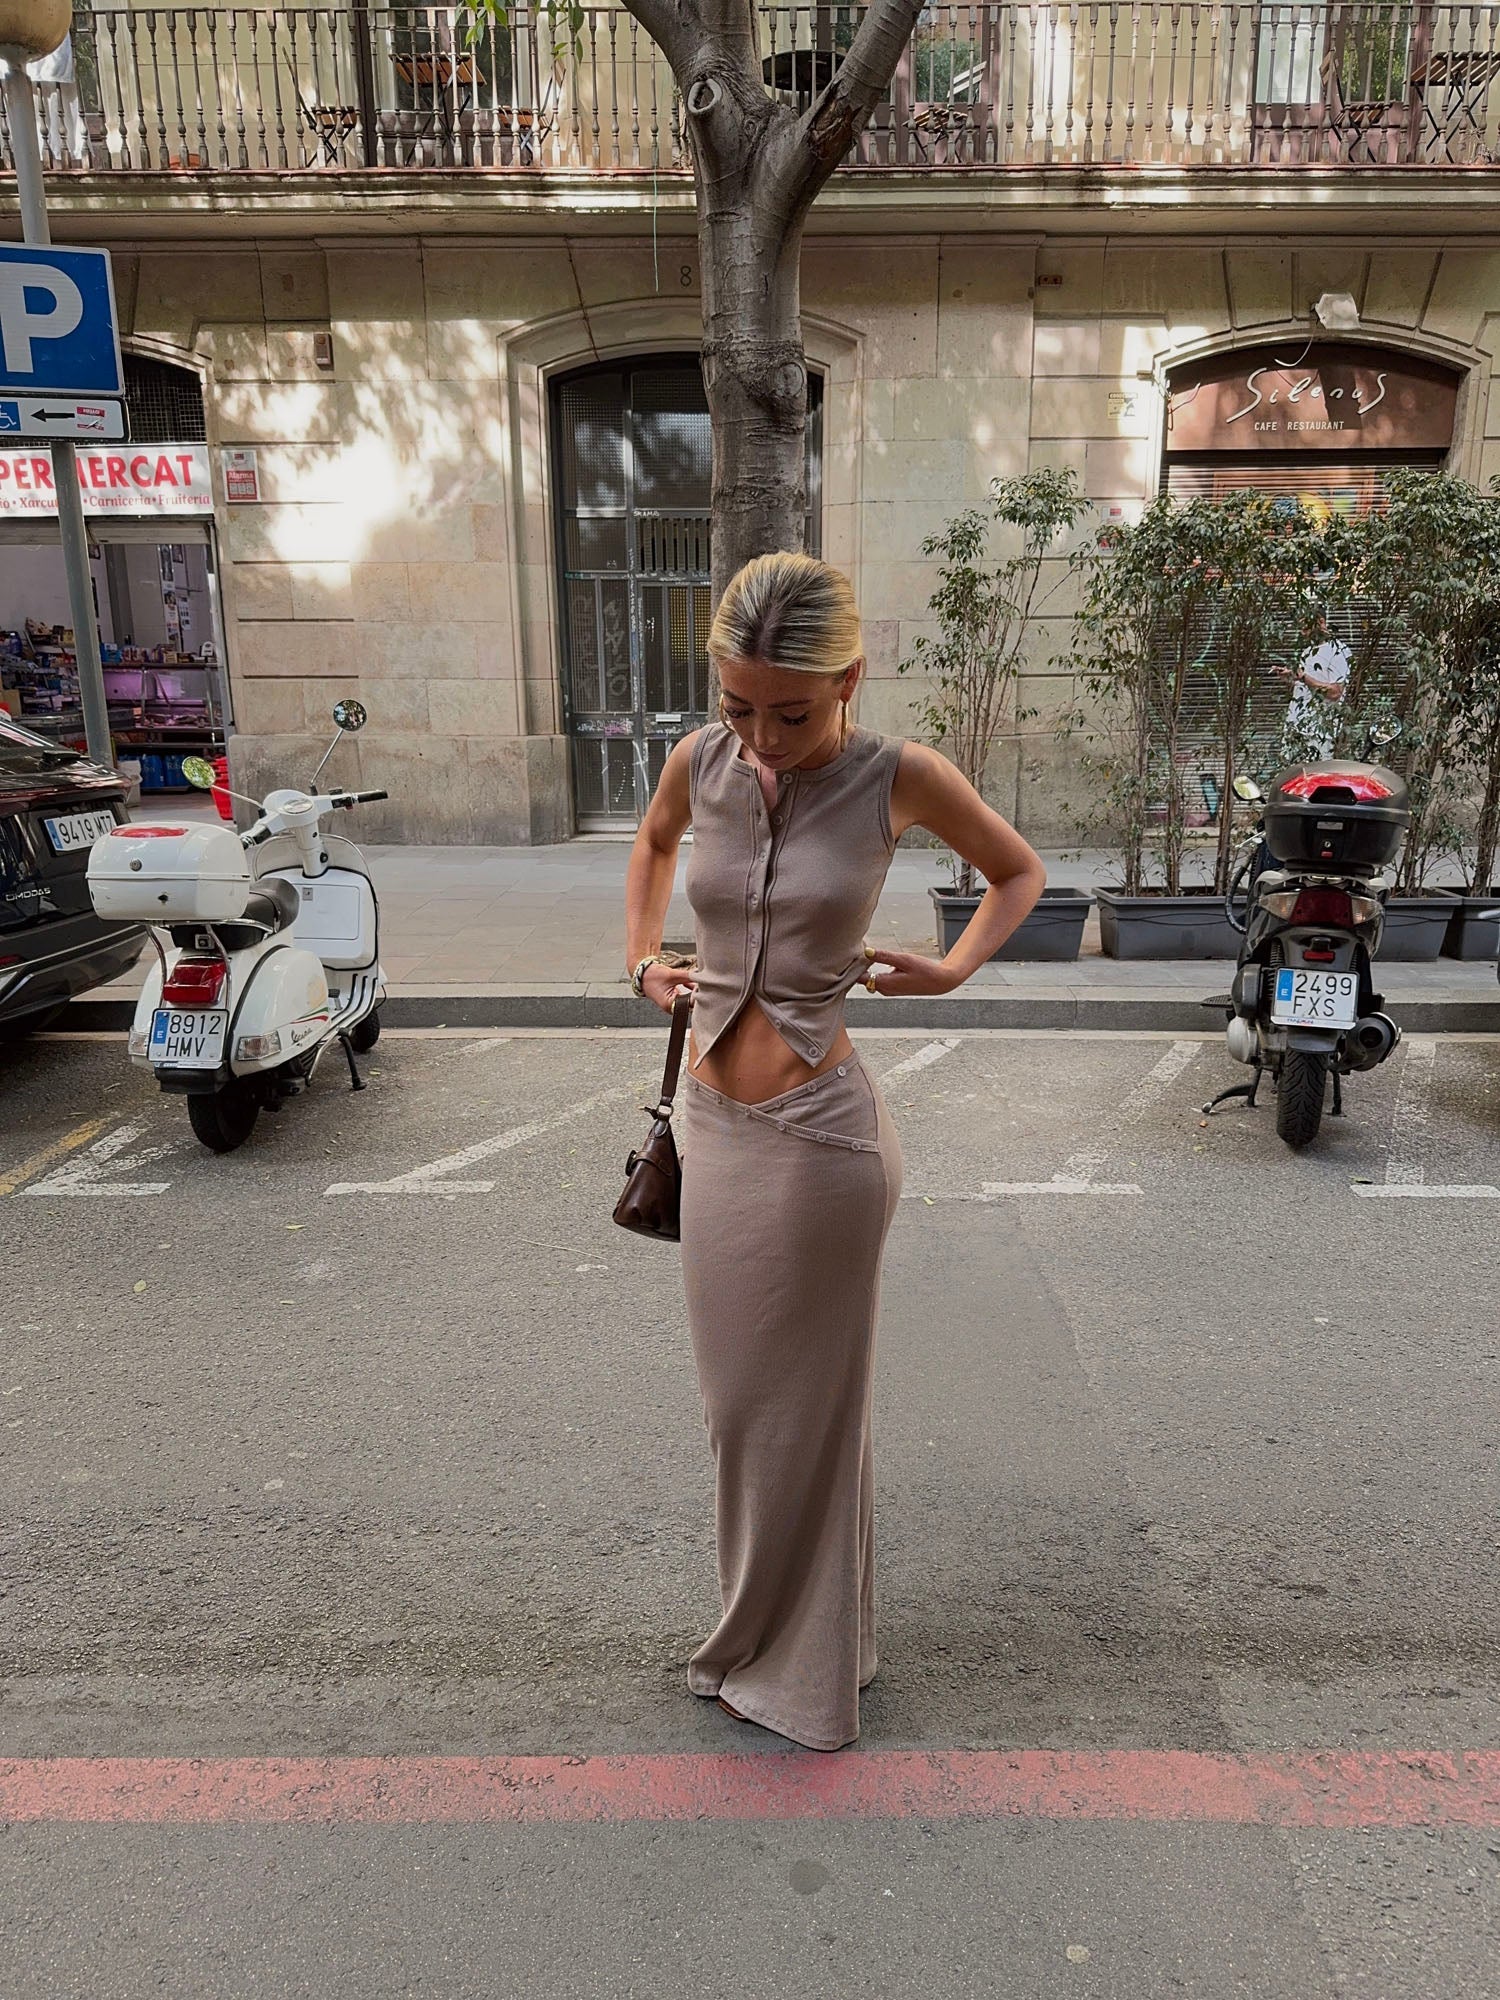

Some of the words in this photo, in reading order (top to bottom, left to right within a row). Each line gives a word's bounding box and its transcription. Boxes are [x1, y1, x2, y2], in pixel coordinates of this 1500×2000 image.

[680, 265, 692, 287] 8
[0, 262, 83, 373] P
[1254, 421, 1278, 431] CAFE
[1287, 421, 1345, 431] RESTAURANT
[19, 497, 59, 508] Xarcu
[58, 818, 95, 844] 9419
[1281, 988, 1289, 996] E
[1294, 973, 1352, 996] 2499
[1292, 995, 1335, 1017] FXS
[156, 1030, 164, 1039] E
[169, 1014, 221, 1035] 8912
[165, 1037, 206, 1057] HMV
